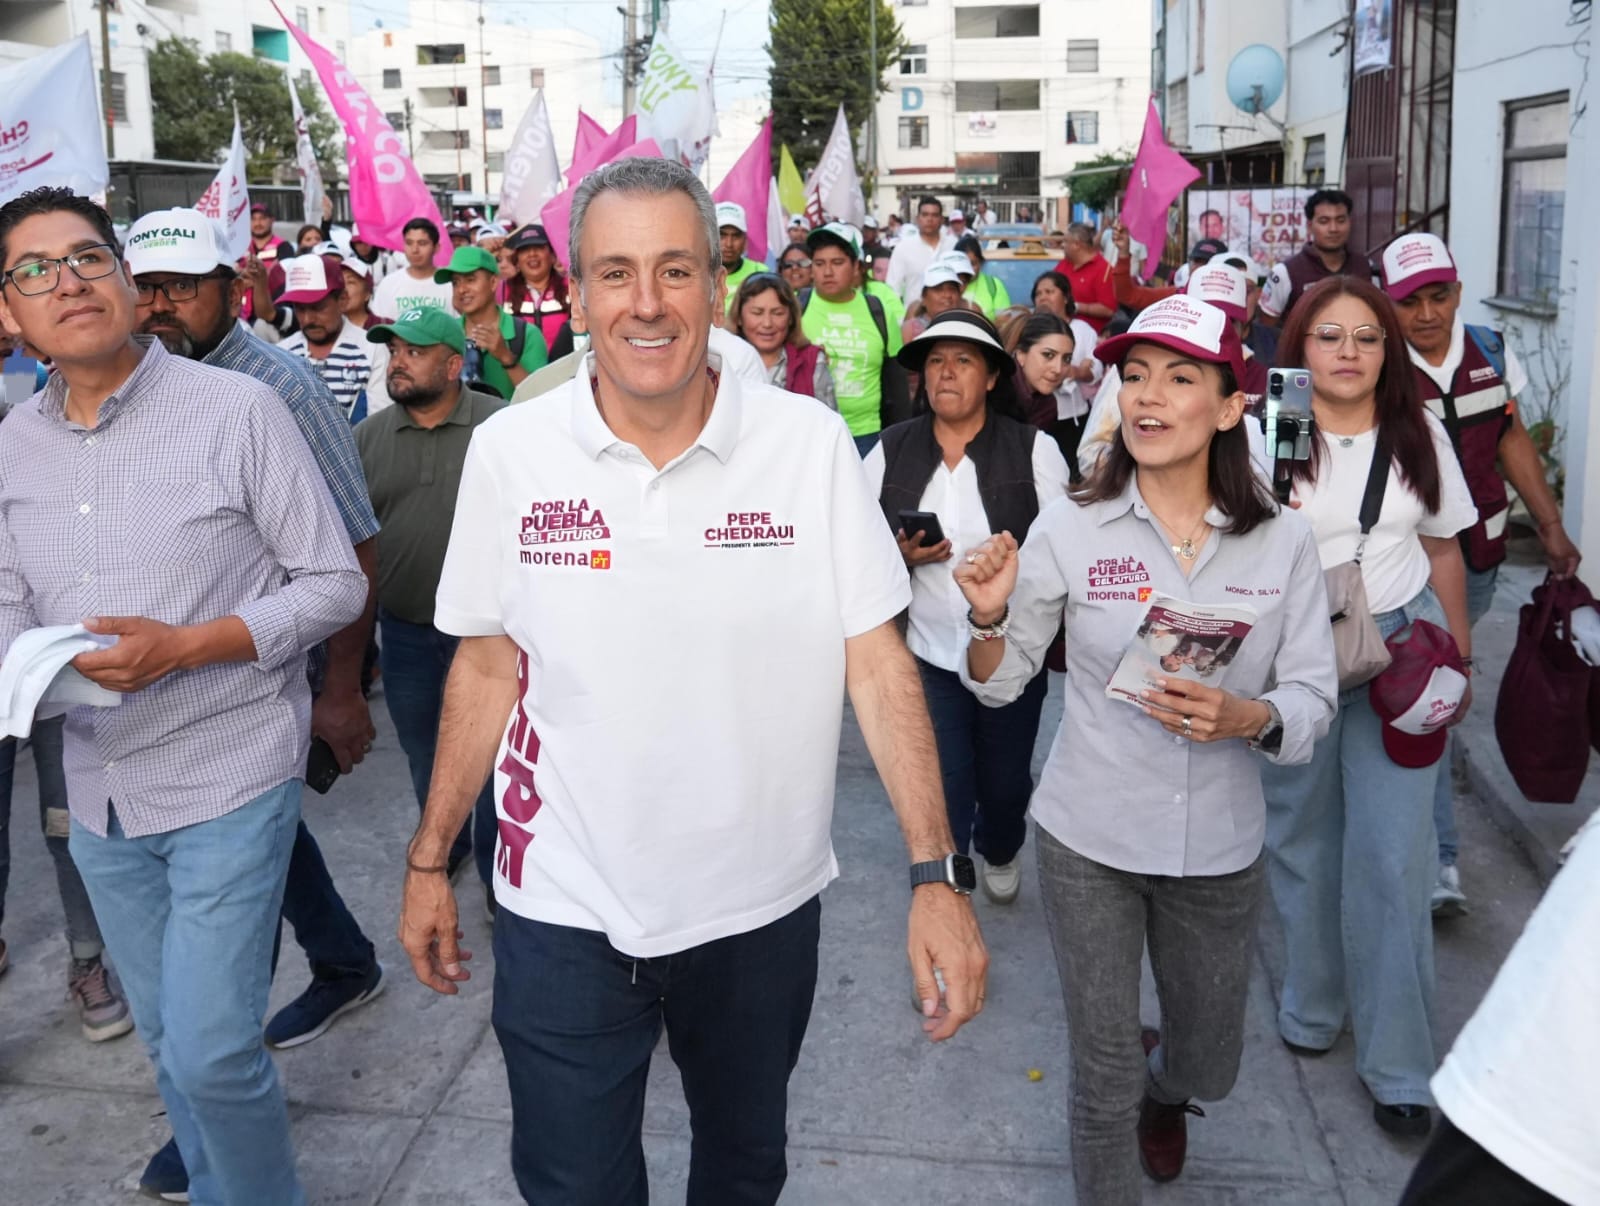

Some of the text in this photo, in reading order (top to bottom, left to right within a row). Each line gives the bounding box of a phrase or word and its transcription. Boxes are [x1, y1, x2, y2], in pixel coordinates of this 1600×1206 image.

[902, 87, 924, 111] D
[128, 229, 159, 246] TONY
[161, 228, 195, 239] GALI
[531, 498, 589, 514] POR LA
[521, 509, 605, 533] PUEBLA
[727, 512, 771, 526] PEPE
[522, 528, 603, 545] DEL FUTURO
[704, 525, 794, 541] CHEDRAUI
[520, 550, 608, 568] morena PT
[1097, 556, 1136, 567] POR LA
[1088, 561, 1145, 577] PUEBLA
[1095, 573, 1147, 586] DEL FUTURO
[1087, 591, 1136, 601] morena
[1258, 588, 1281, 596] SILVA
